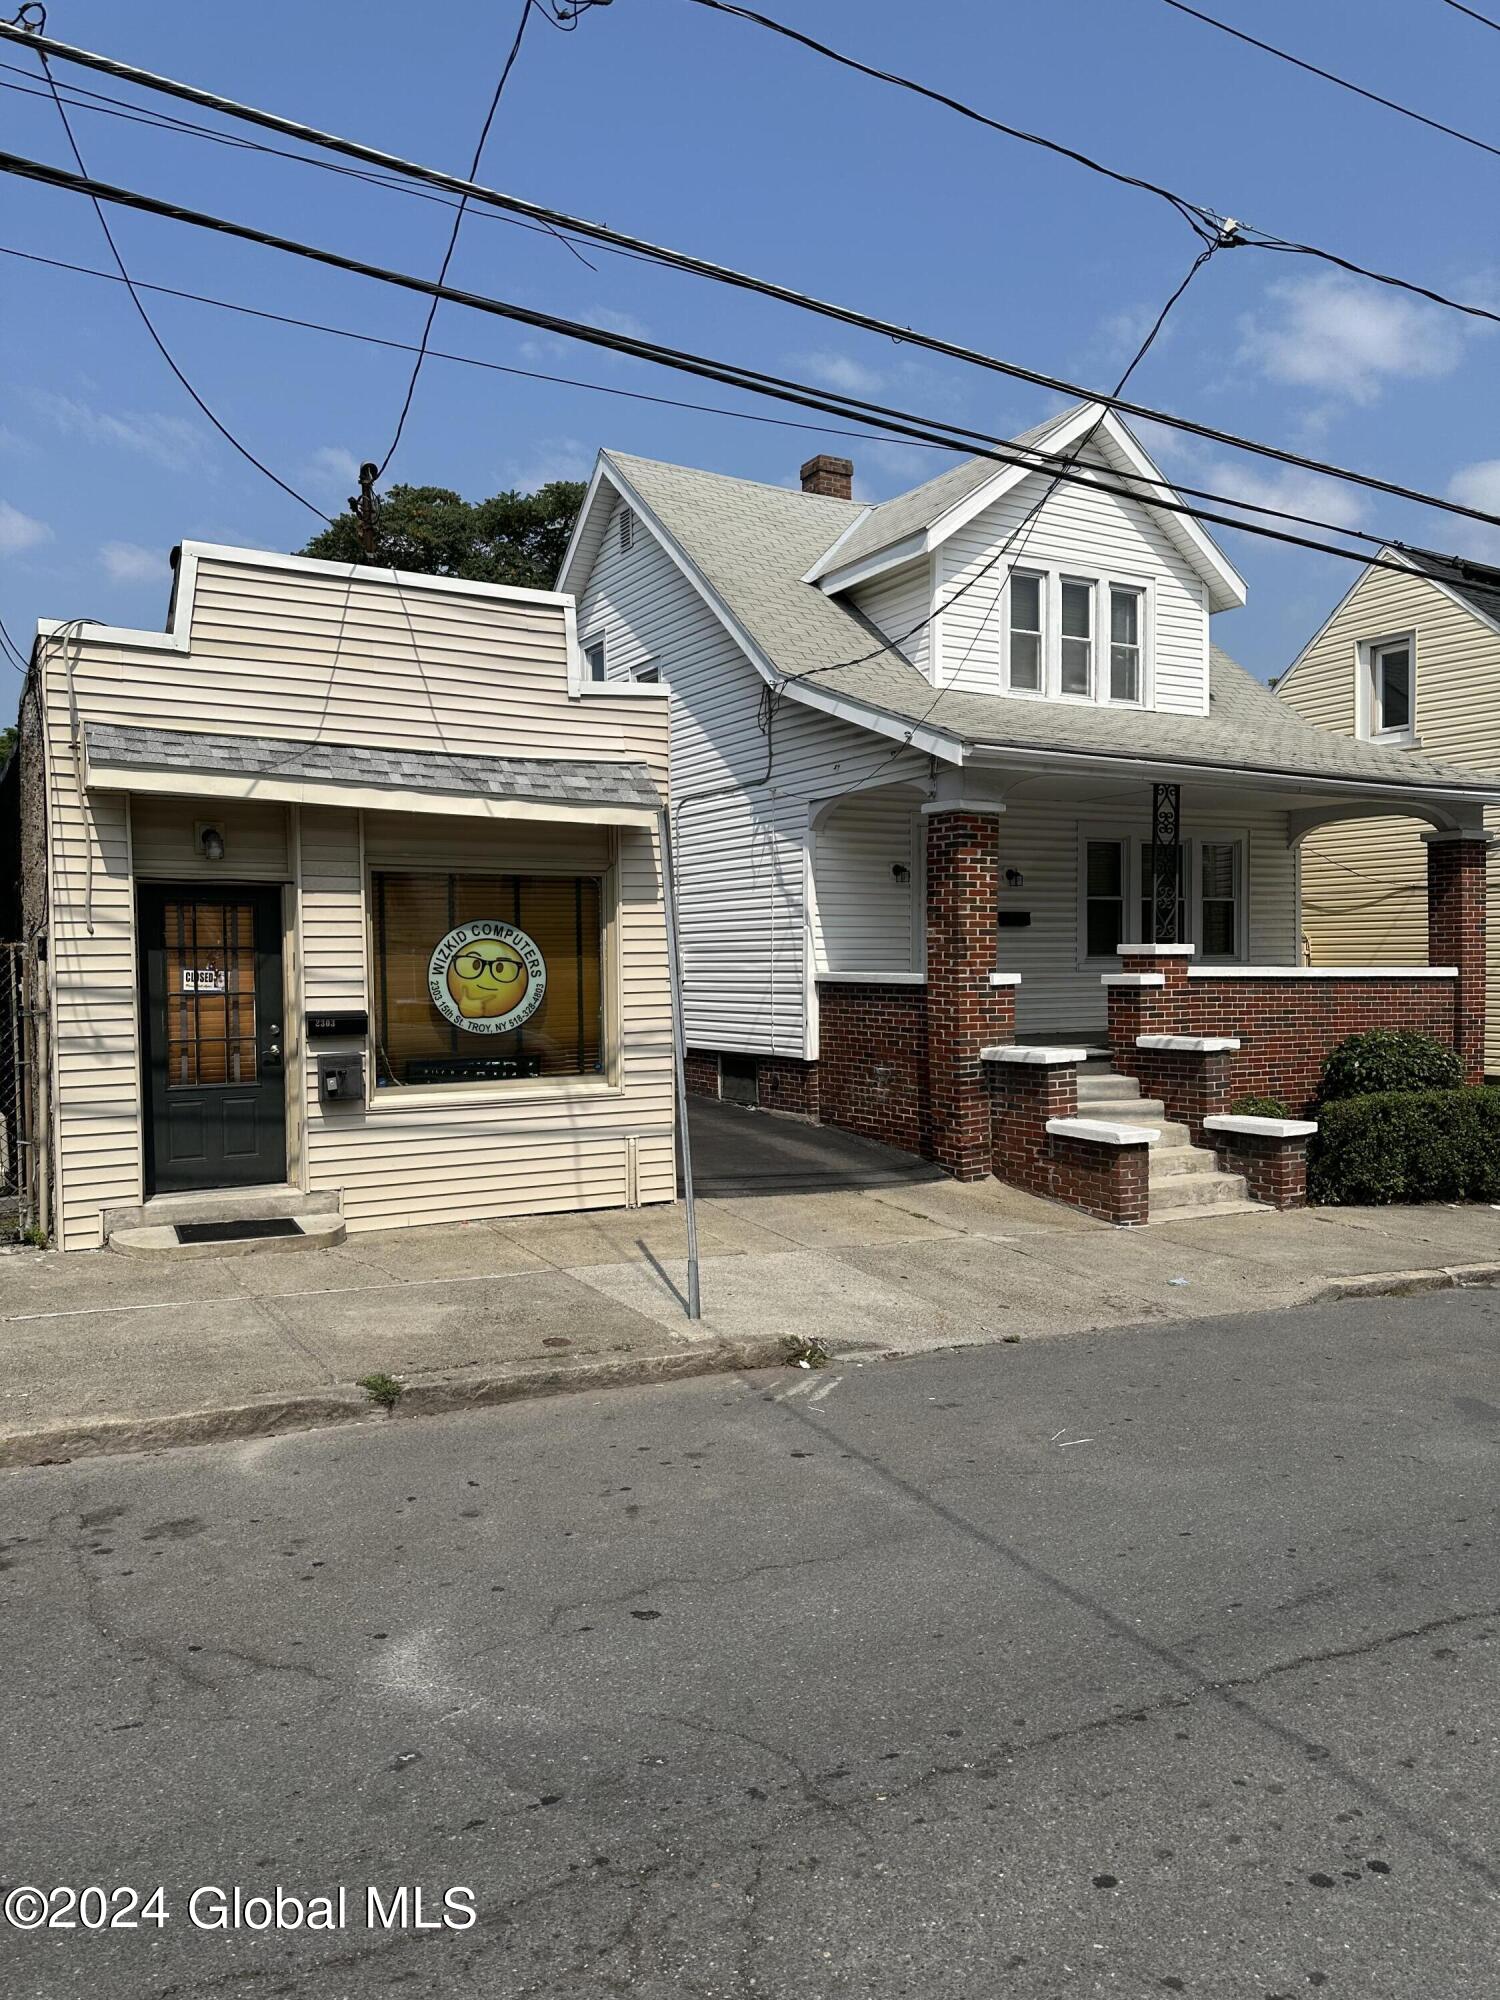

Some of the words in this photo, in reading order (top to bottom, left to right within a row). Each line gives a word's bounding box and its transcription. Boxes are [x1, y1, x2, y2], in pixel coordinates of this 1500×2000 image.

[432, 931, 467, 976] WIZKID
[471, 924, 542, 978] COMPUTERS
[185, 972, 213, 982] CLSED
[430, 980, 443, 1001] 2303
[438, 1001, 454, 1019] 15th
[468, 1021, 493, 1033] TROY,
[495, 1021, 507, 1031] NY
[509, 984, 544, 1027] 518-328-4803
[315, 1019, 336, 1028] 2303
